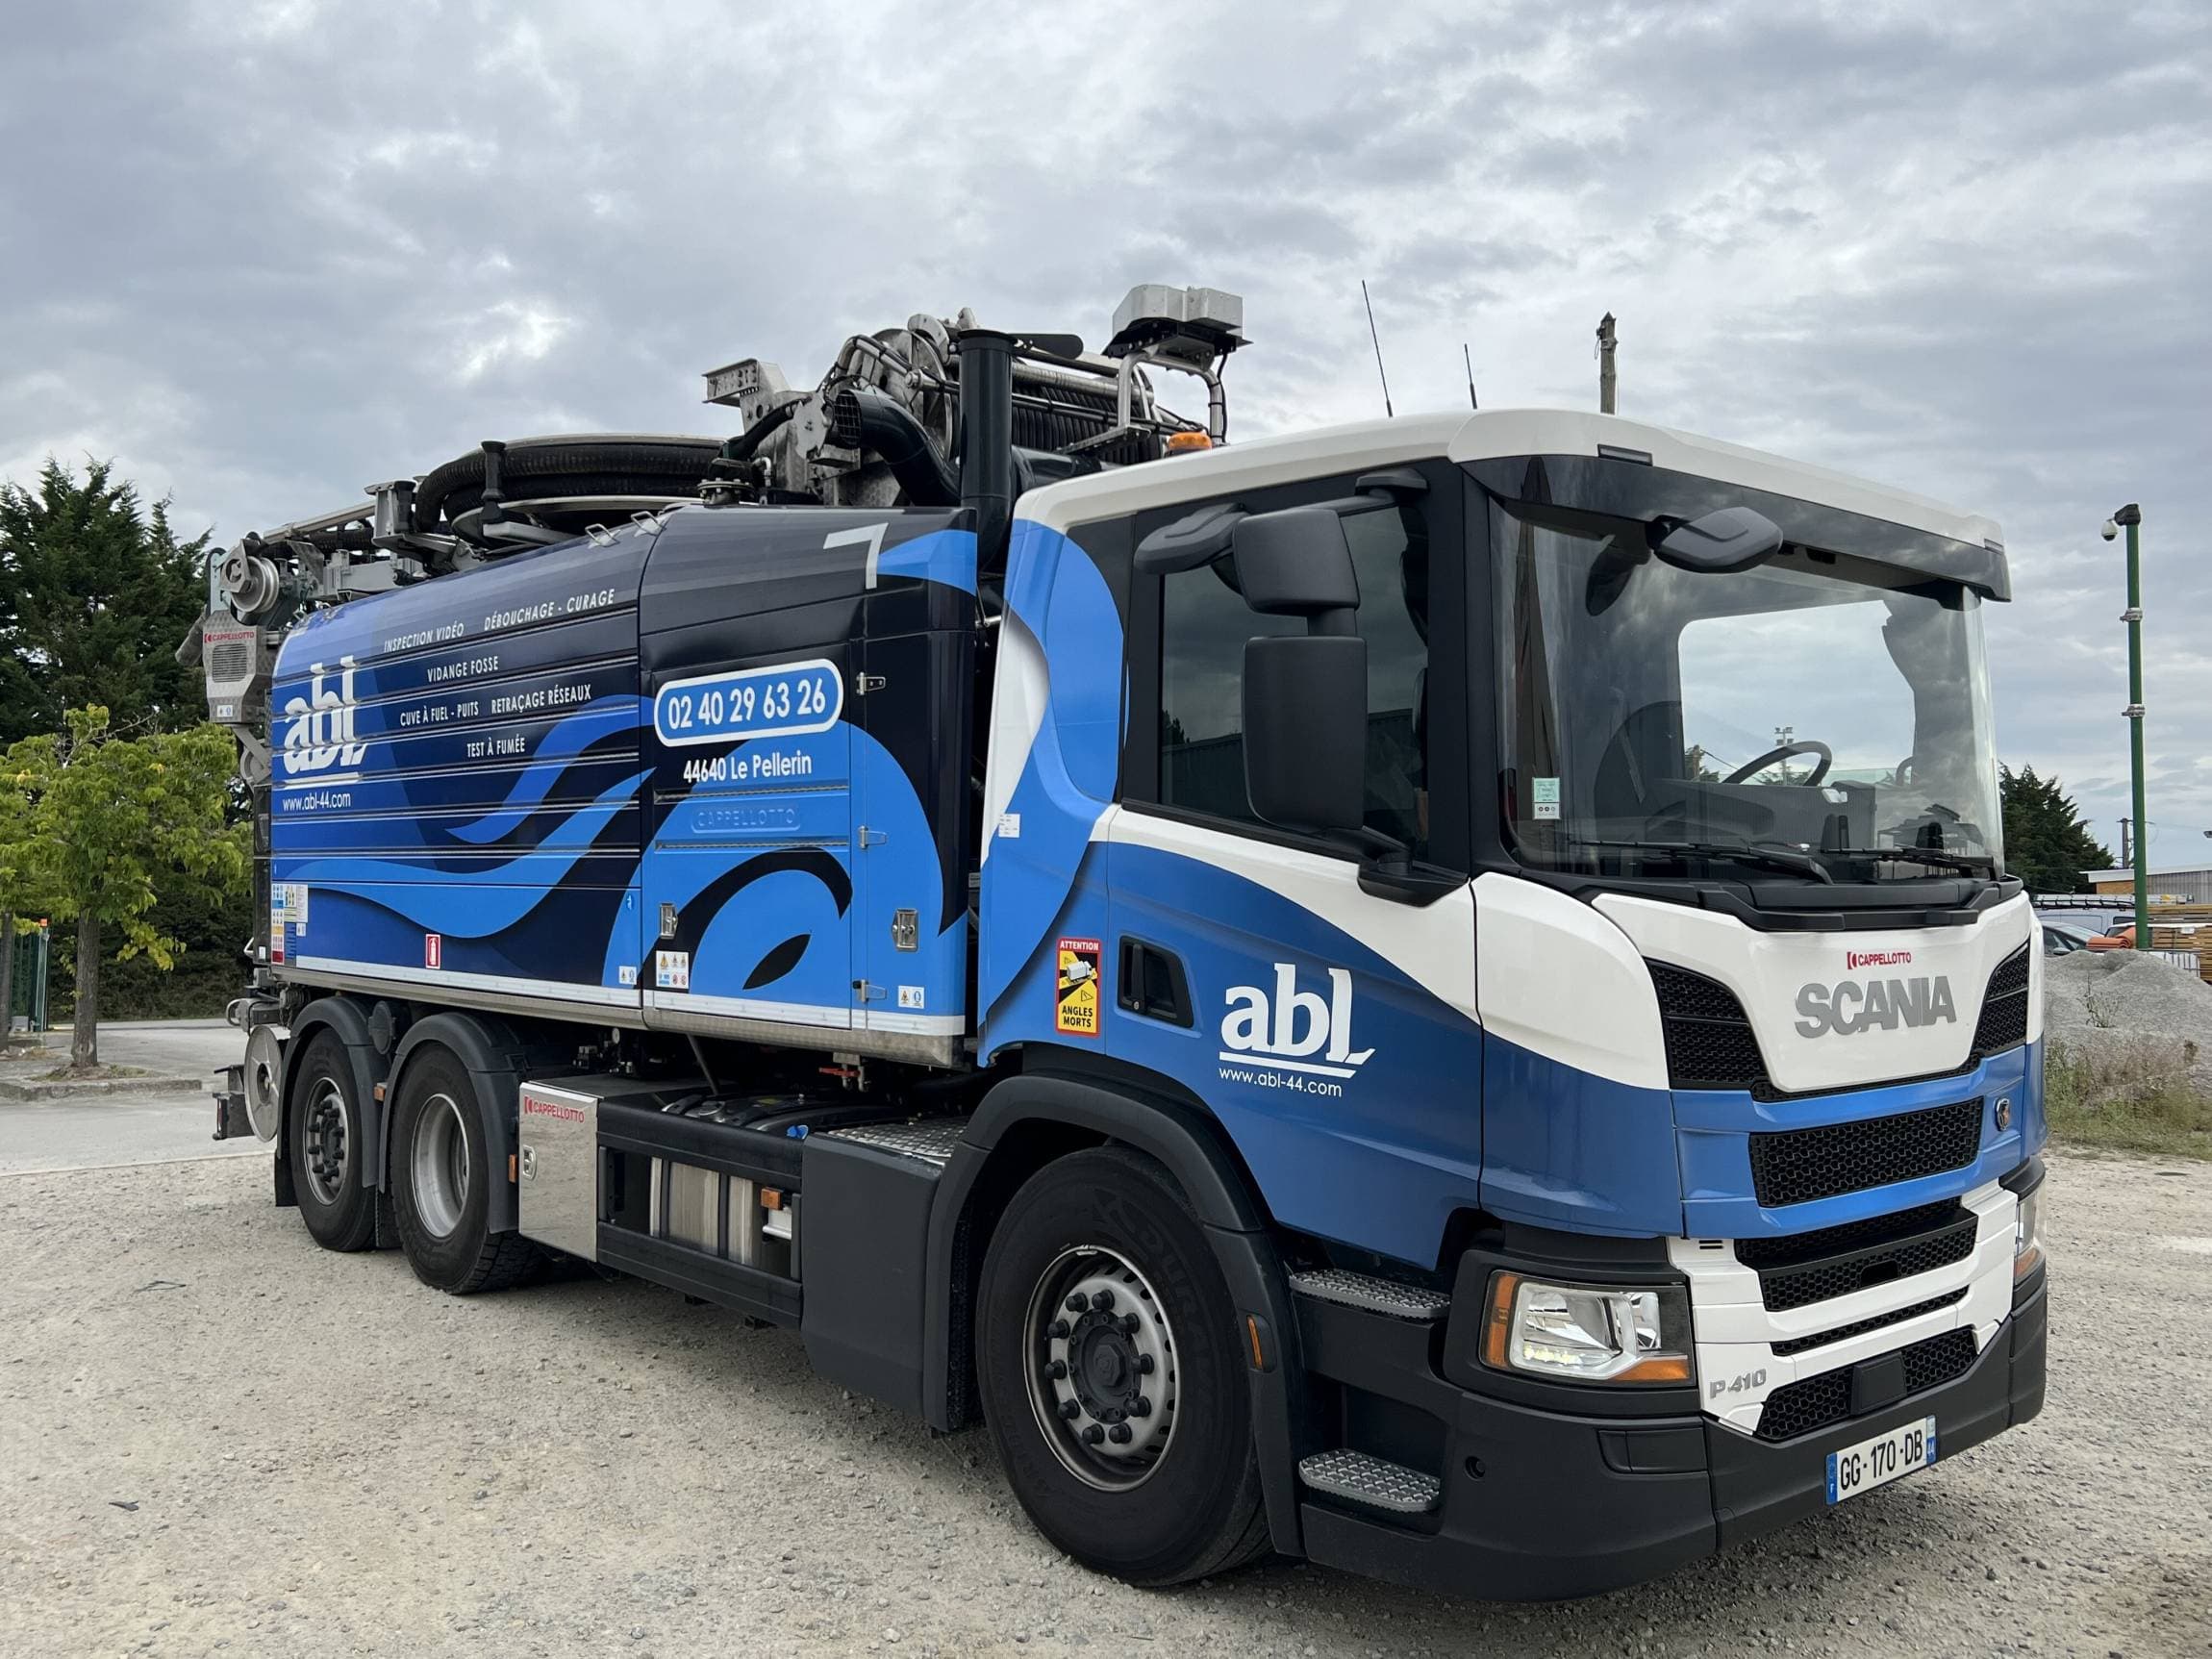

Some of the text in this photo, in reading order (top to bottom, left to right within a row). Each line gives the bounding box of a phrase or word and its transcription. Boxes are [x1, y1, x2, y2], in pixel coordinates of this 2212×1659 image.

[484, 601, 554, 631] DÉBOUCHAGE
[566, 589, 616, 613] CURAGE
[213, 631, 254, 641] CAPPELLOTTO
[384, 621, 465, 652] INSPECTION VIDÉO
[427, 656, 499, 683] VIDANGE FOSSE
[491, 684, 591, 715] RETRAÇAGE RÉSEAUX
[667, 677, 826, 730] 02 40 29 63 26
[283, 655, 368, 774] abl
[400, 711, 421, 726] CUVE
[422, 706, 429, 723] À
[431, 707, 448, 722] FUEL
[457, 701, 479, 718] PUITS
[466, 733, 525, 758] TEST À FUMÉE
[683, 749, 812, 783] 44640 Le Pellerin
[282, 792, 351, 811] www.abl-44.com
[1060, 940, 1099, 951] ATTENTION
[1857, 952, 1912, 967] CAPPELLOTTO
[1062, 1005, 1093, 1017] ANGLES
[1220, 963, 1376, 1066] abl
[1795, 975, 1957, 1039] SCANIA
[1063, 1016, 1092, 1027] MORTS
[1219, 1068, 1343, 1097] www.abl-44.com
[533, 1101, 585, 1123] CAPPELLOTTO
